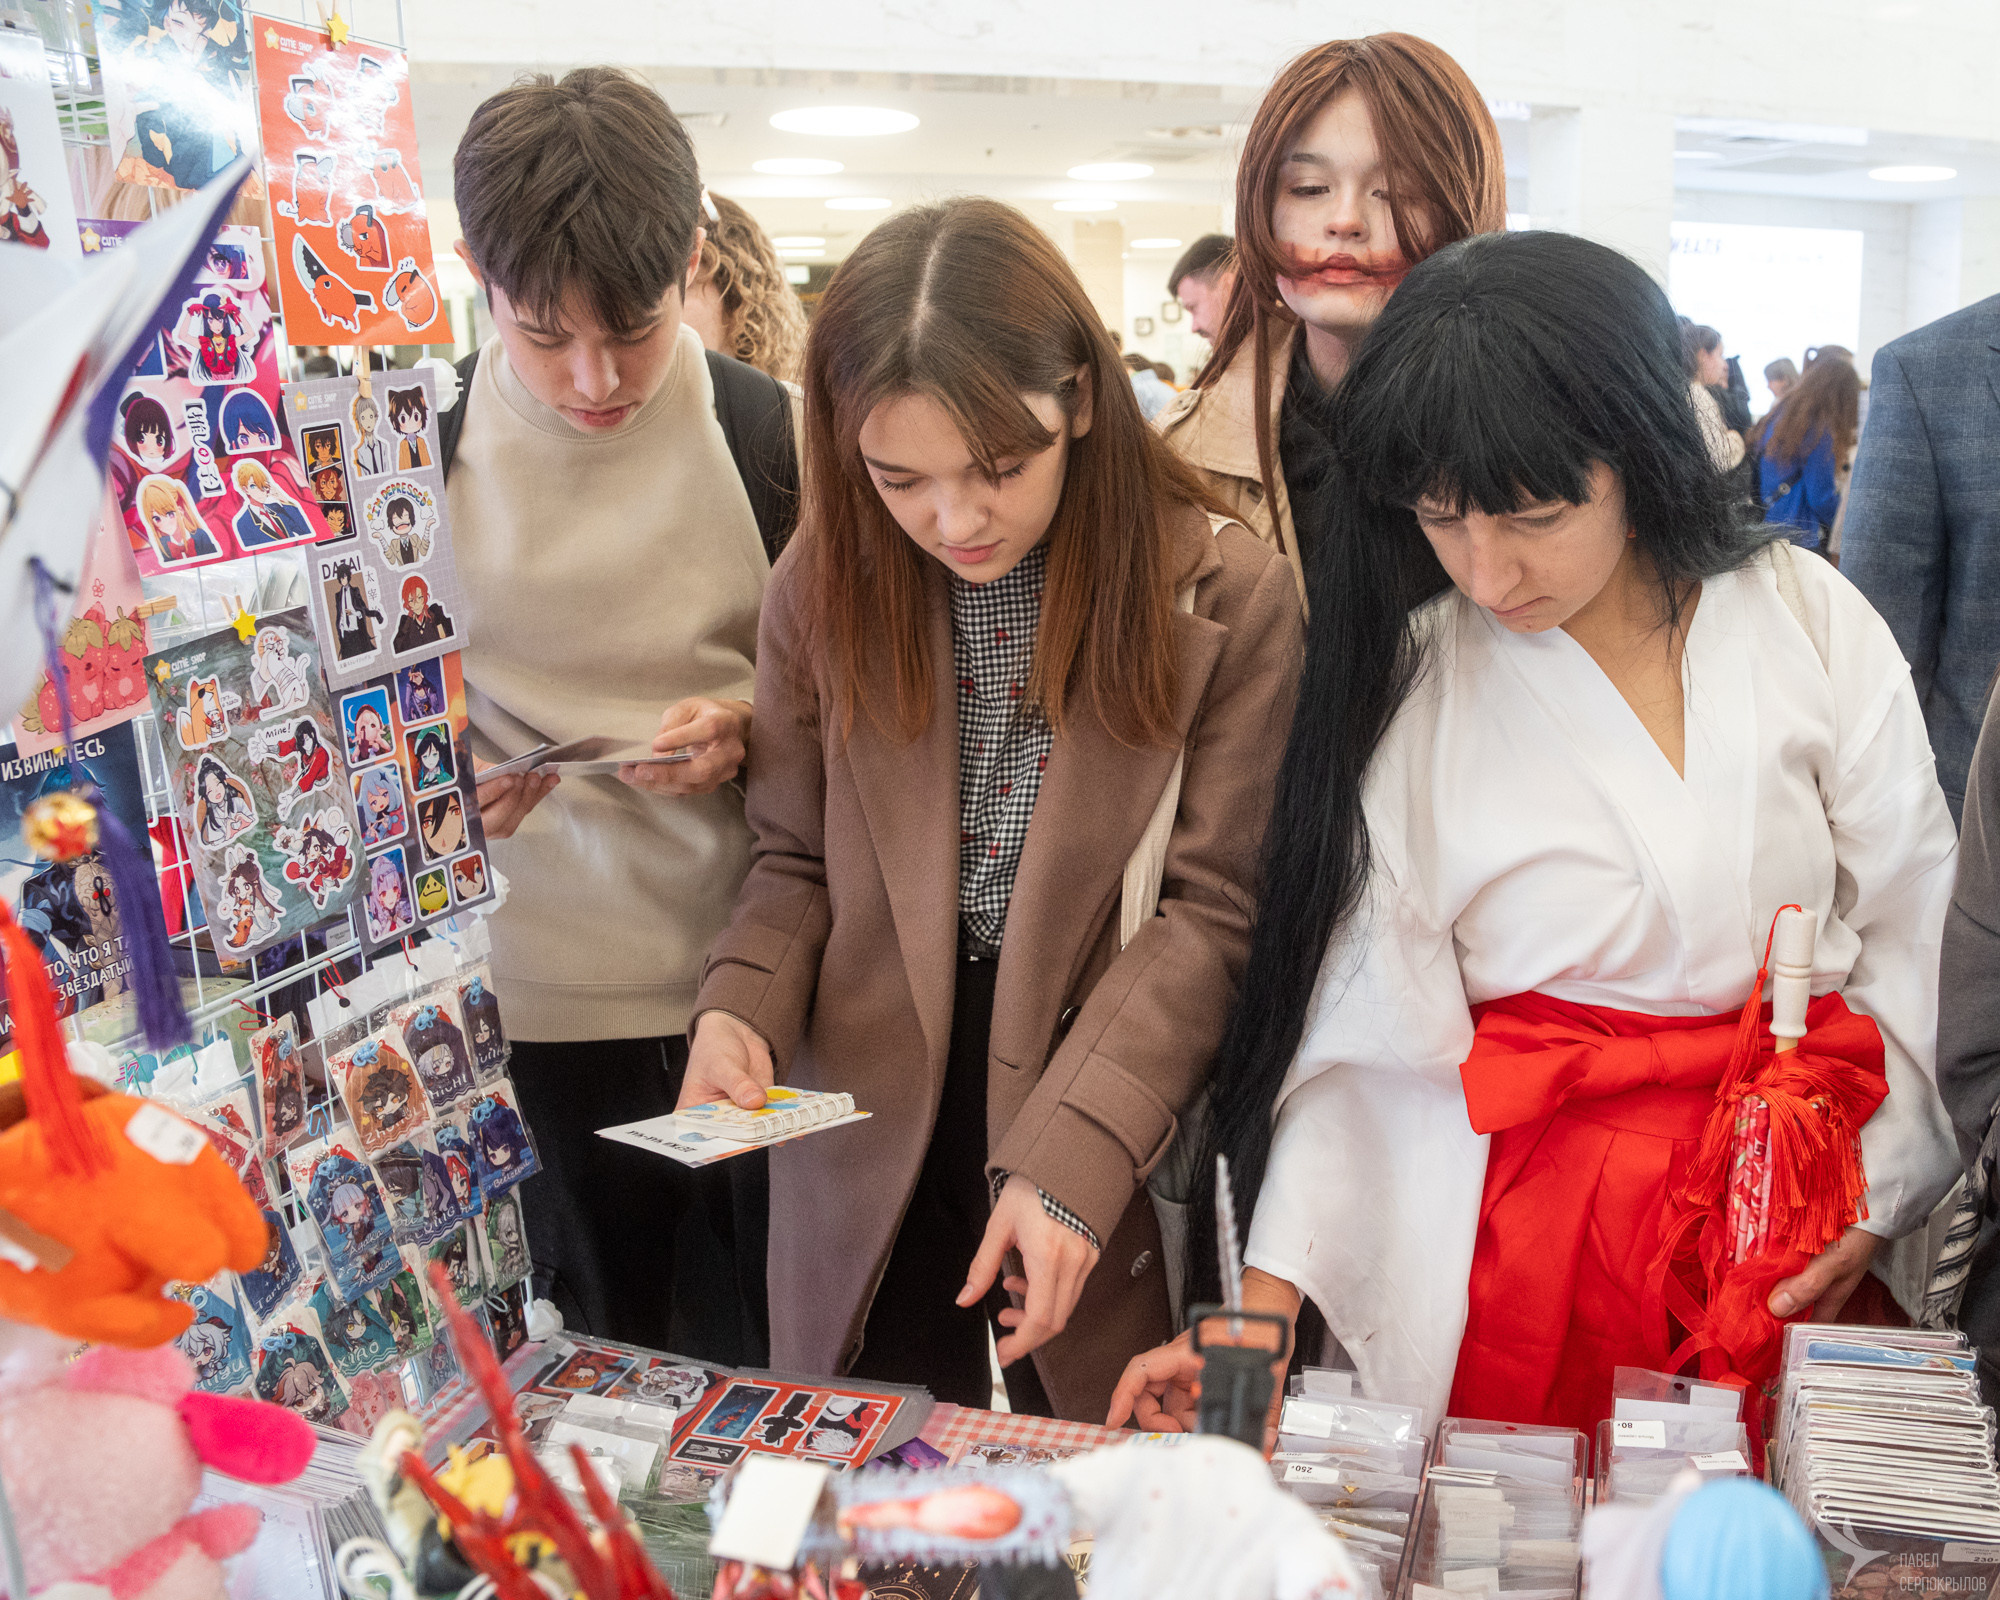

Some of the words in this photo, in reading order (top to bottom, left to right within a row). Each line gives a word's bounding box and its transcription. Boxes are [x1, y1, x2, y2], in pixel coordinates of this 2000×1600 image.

[380, 482, 426, 507] DEPRESSED
[265, 722, 291, 739] Mine!
[70, 946, 99, 969] ЧТО
[102, 942, 112, 958] Я
[349, 1228, 386, 1258] Ayaka
[359, 1257, 395, 1287] Ayaka
